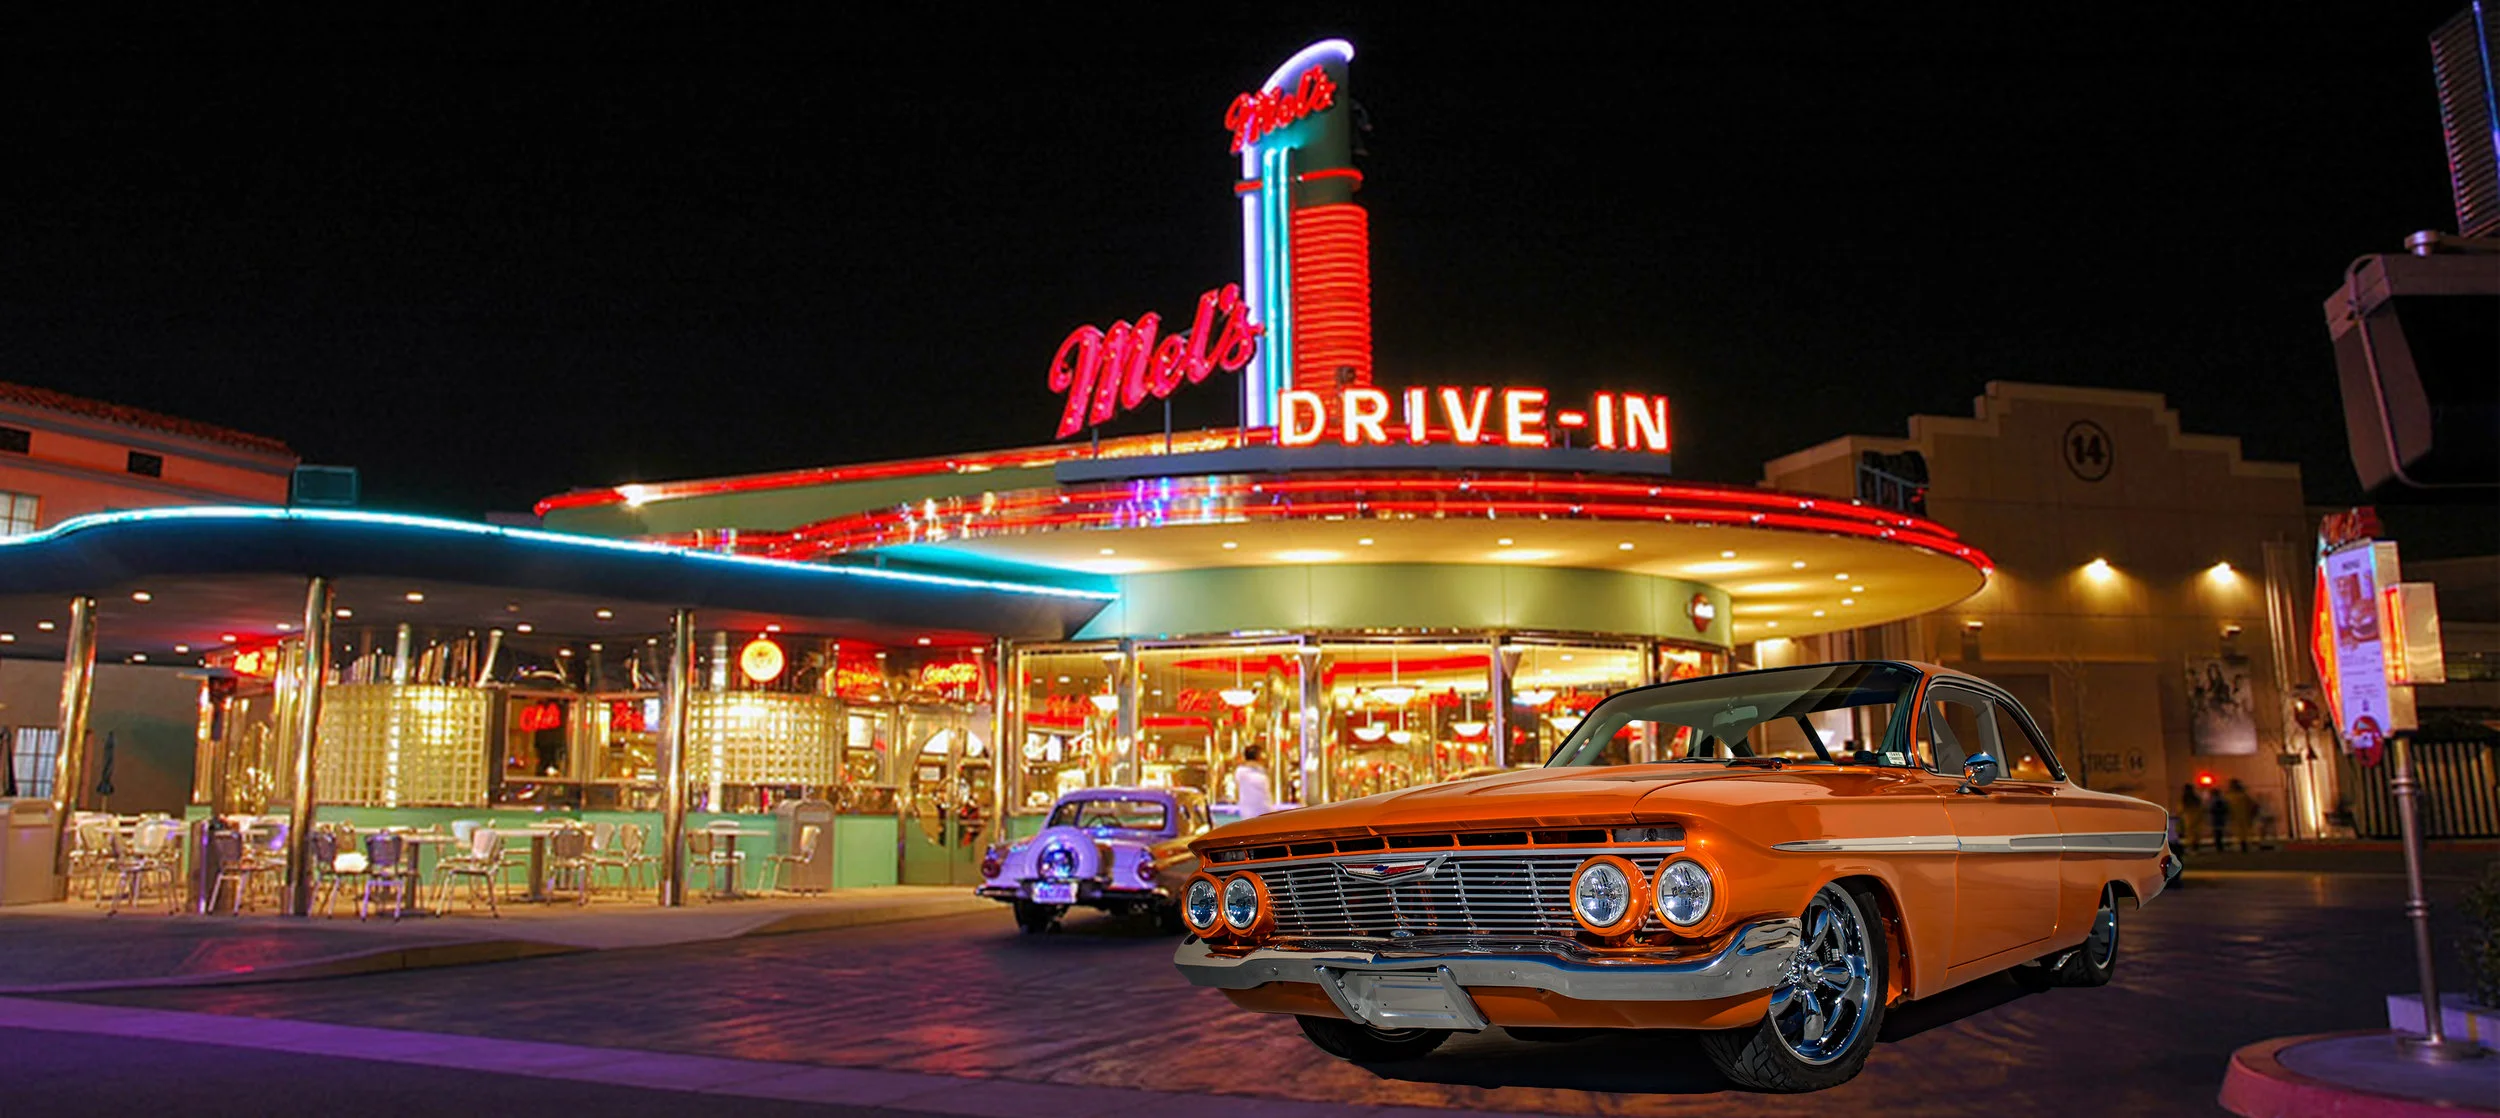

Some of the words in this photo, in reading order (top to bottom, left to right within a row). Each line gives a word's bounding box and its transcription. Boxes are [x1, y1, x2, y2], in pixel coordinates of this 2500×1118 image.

[1224, 65, 1337, 154] Mel's
[1048, 283, 1265, 439] Mel's
[1278, 386, 1670, 451] DRIVE-IN
[2072, 434, 2107, 465] 14
